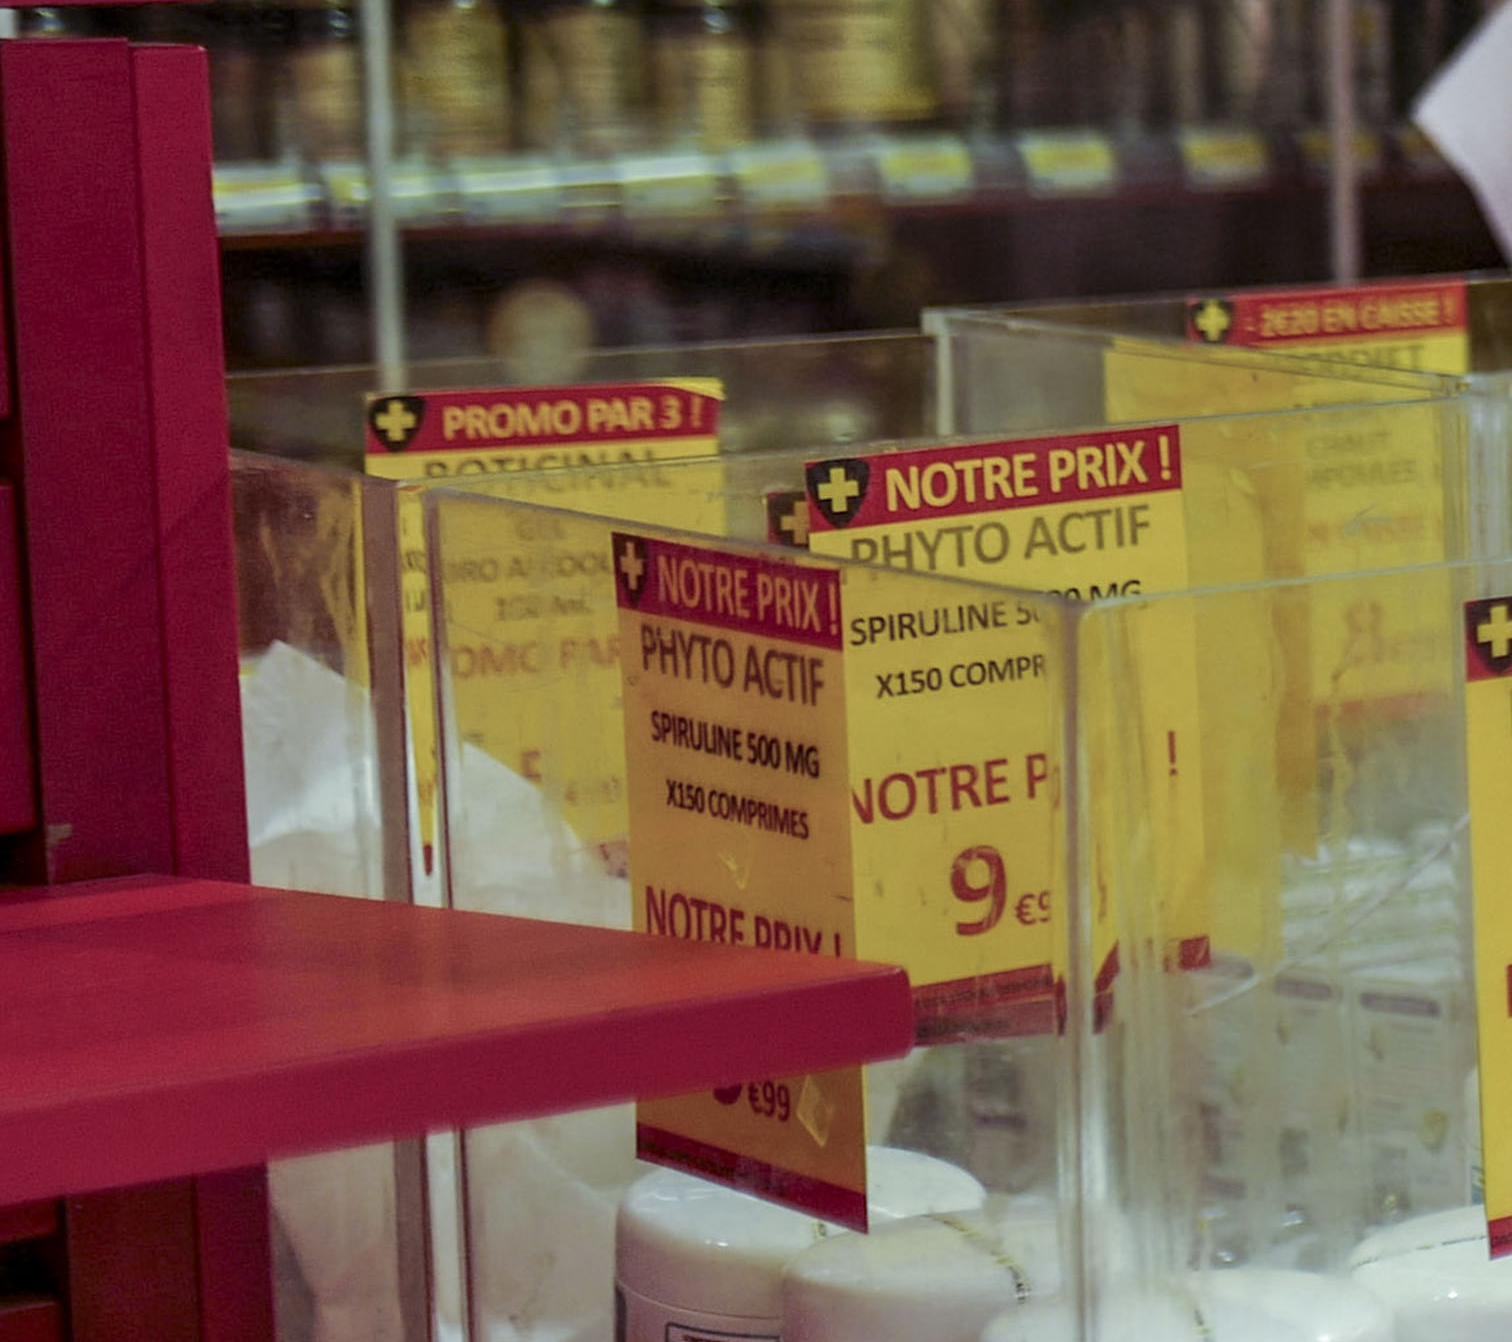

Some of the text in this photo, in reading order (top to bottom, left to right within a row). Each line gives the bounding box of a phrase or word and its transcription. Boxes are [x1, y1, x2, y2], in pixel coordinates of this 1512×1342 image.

[442, 398, 581, 442] PROMO
[587, 396, 654, 435] PAR
[662, 395, 684, 432] 3
[884, 435, 1173, 514] NOTRE PRIX !
[850, 503, 1152, 574] PHYTO ACTIF
[656, 553, 752, 619] NOTRE
[755, 573, 821, 632] PRIX
[849, 602, 1008, 647] SPIRULINE
[640, 628, 735, 692] PHYTO
[740, 647, 827, 709] ACTIF
[875, 653, 1048, 700] X150 COMPR
[650, 710, 822, 782] SPIRULINE 500 MG
[664, 777, 811, 842] X150 COMPRIMES
[850, 754, 1010, 827] NOTRE
[645, 885, 745, 948] NOTRE
[711, 1079, 792, 1123] €99
